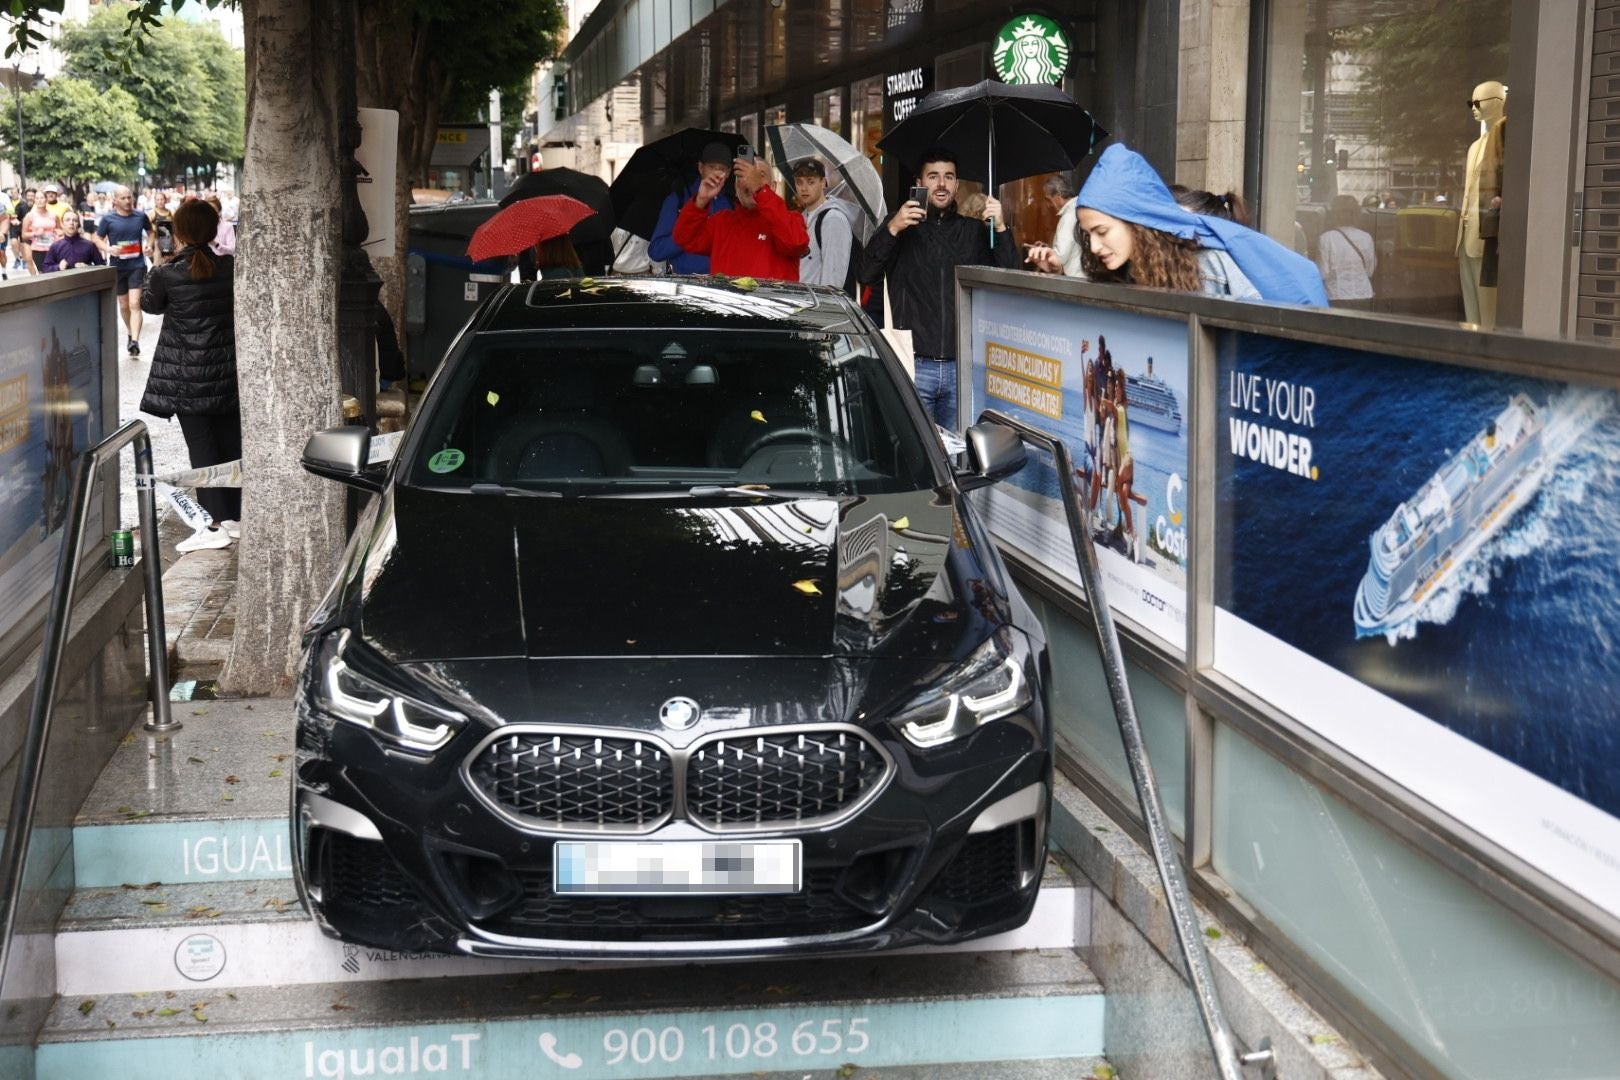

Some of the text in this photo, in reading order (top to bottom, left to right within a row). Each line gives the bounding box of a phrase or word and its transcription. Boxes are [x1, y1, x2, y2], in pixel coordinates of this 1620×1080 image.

[886, 67, 924, 97] STARBUCKS
[988, 346, 1060, 385] ¡BEBIDAS INCLUIDAS Y
[988, 374, 1060, 416] EXCURSIONES GRATIS!
[1230, 370, 1315, 428] LIVE YOUR
[1229, 417, 1320, 481] WONDER.
[170, 490, 197, 521] VALENCIA
[183, 834, 293, 876] IGUAL
[304, 1018, 869, 1080] IgualaT 900 108 655
